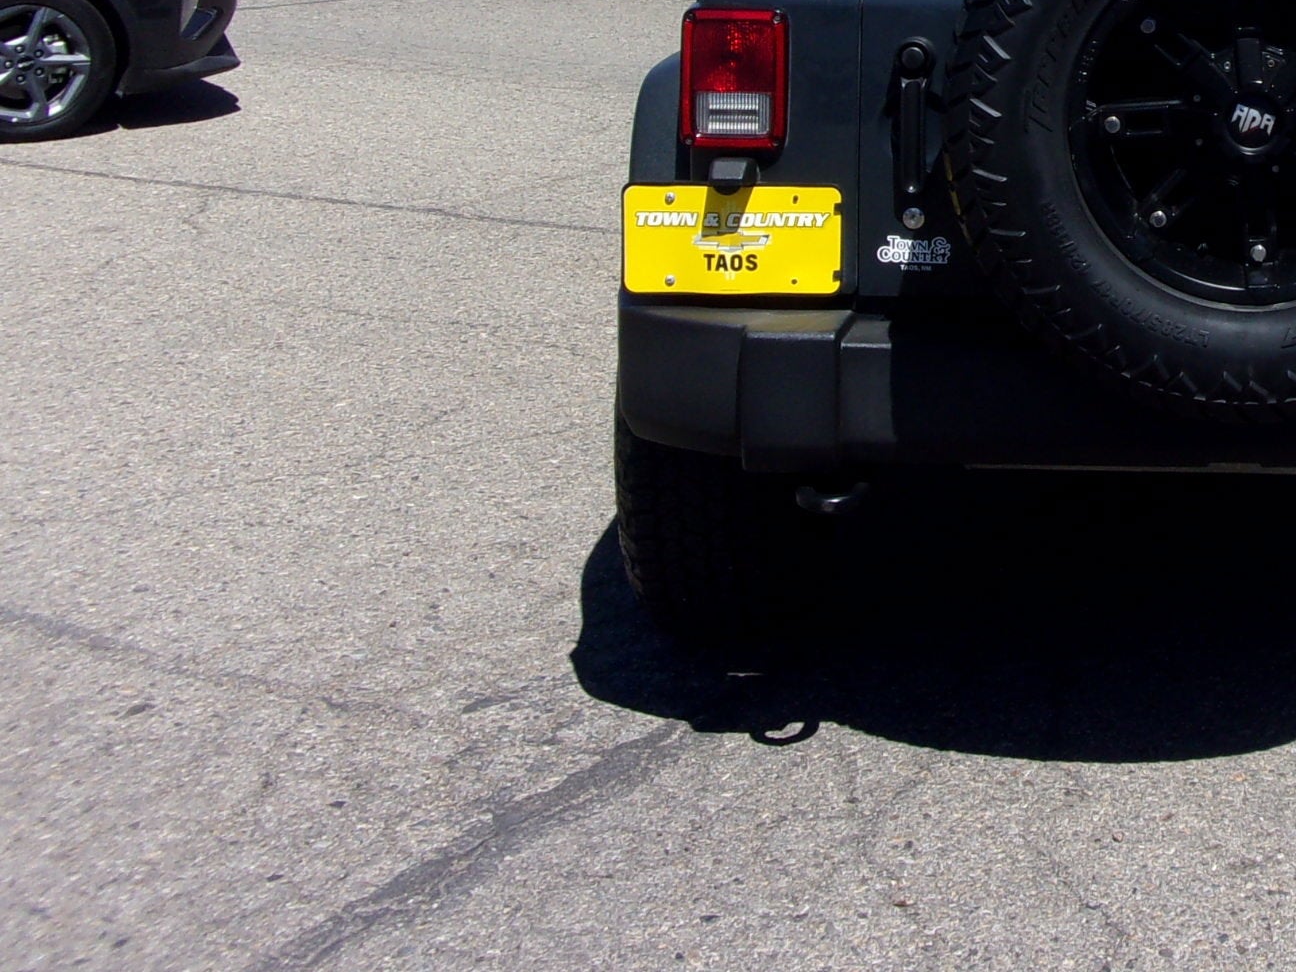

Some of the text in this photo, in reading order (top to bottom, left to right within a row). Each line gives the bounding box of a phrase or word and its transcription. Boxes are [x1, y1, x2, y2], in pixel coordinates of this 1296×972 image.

[635, 211, 830, 228] TOWN & COUNTRY
[932, 237, 951, 254] &
[703, 253, 759, 272] TAOS
